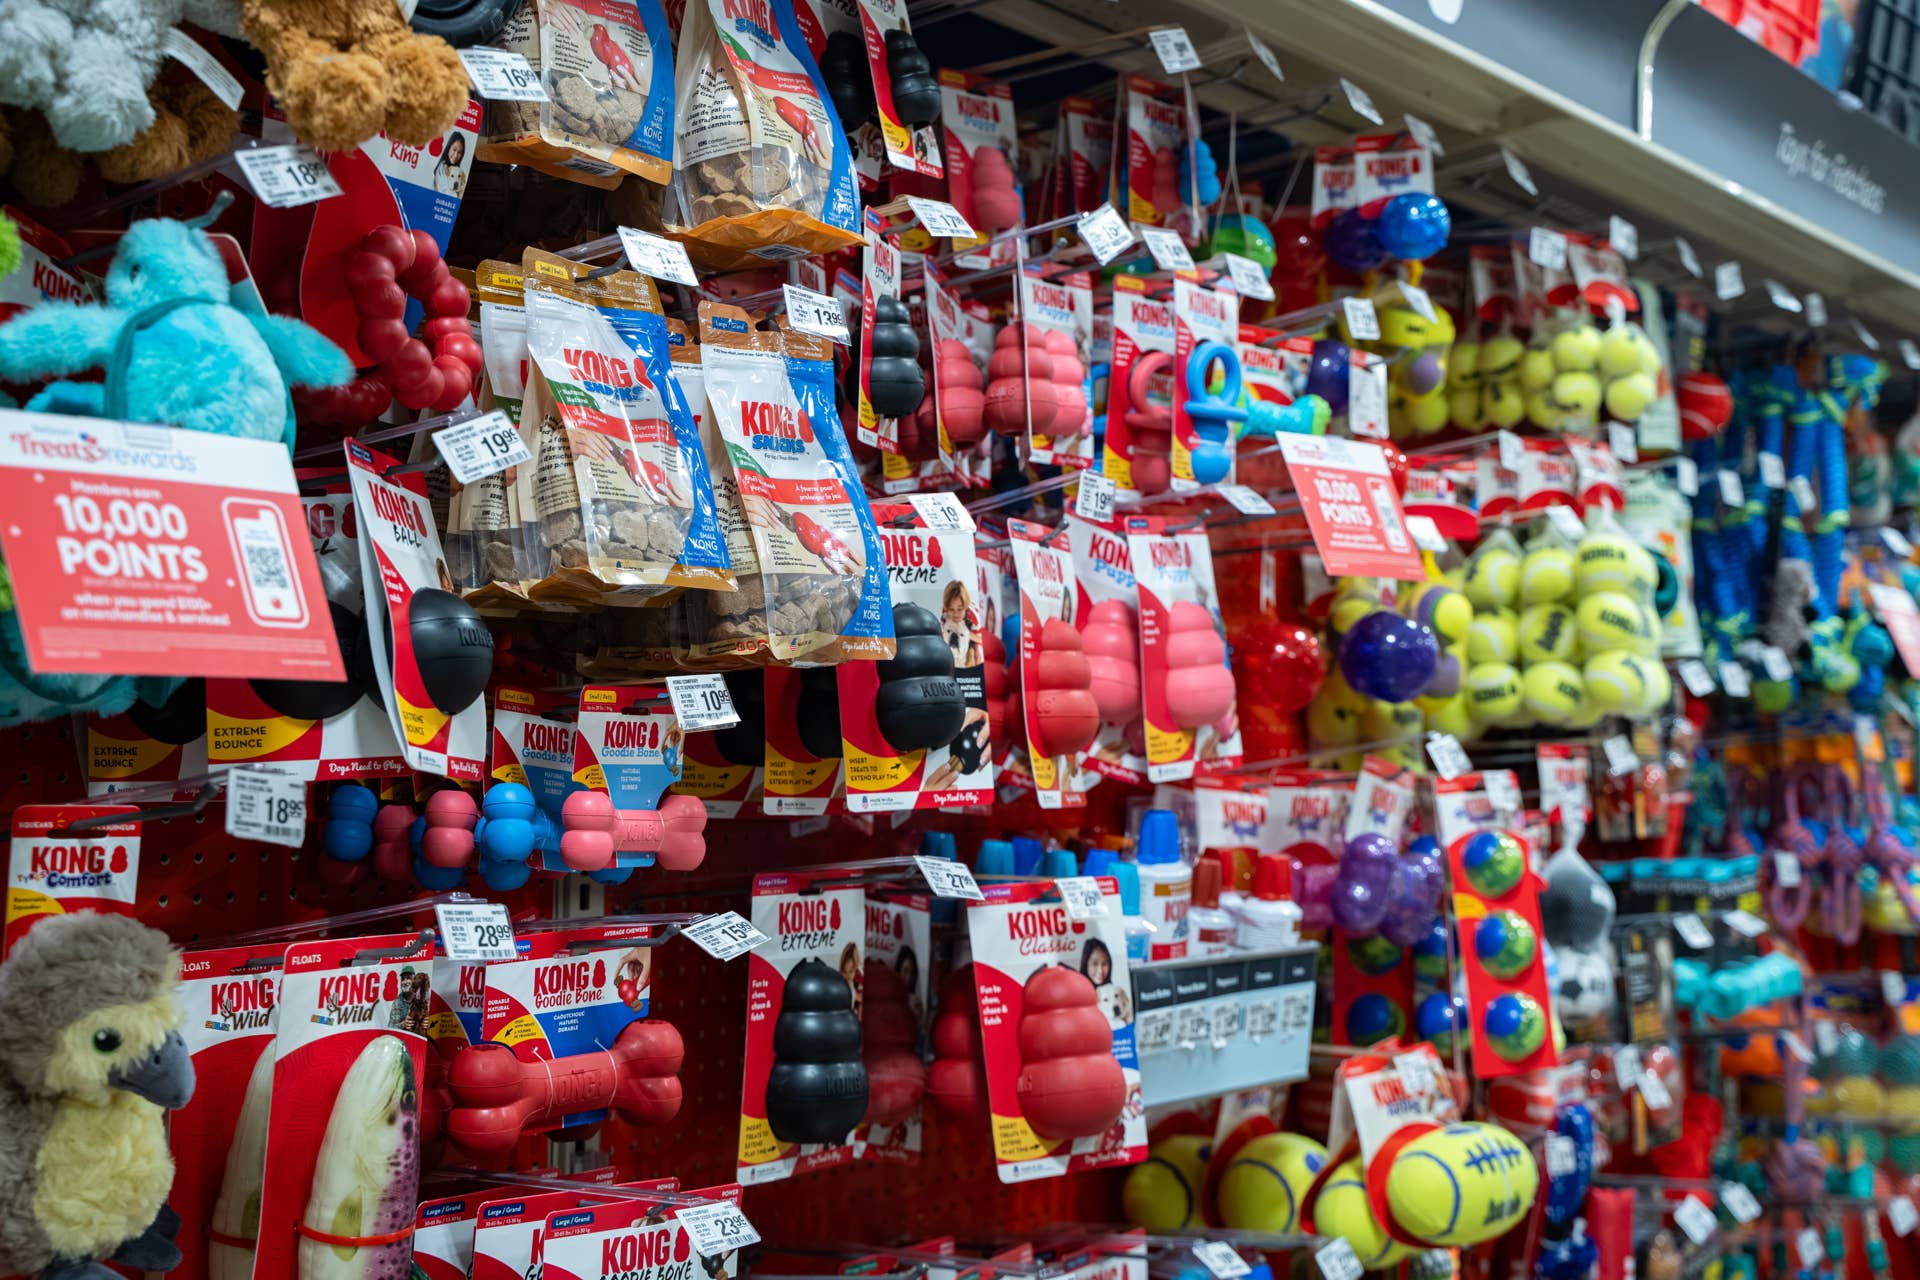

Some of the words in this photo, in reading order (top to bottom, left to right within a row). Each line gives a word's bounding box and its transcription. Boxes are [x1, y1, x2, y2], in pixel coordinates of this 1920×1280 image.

[643, 124, 663, 142] KONG
[390, 139, 419, 169] Ring
[1031, 283, 1066, 308] KONG
[1131, 301, 1168, 327] KONG
[564, 348, 633, 387] KONG
[741, 401, 795, 440] KONG
[752, 434, 805, 454] SNACKS
[102, 448, 198, 473] rewards
[367, 480, 416, 532] KONG
[1318, 500, 1373, 527] POINTS
[55, 494, 189, 542] 10,000
[393, 524, 422, 548] BALL
[691, 537, 718, 551] KONG
[56, 537, 209, 583] POINTS
[883, 535, 923, 567] ONG
[1093, 558, 1137, 587] Pupp
[863, 608, 881, 621] KONG
[457, 627, 495, 648] KONG
[920, 682, 956, 699] KONG
[214, 726, 267, 738] EXTREME
[523, 721, 569, 754] KONG
[604, 720, 648, 749] KONG
[94, 746, 138, 758] EXTREME
[214, 738, 263, 750] BOUNCE
[601, 746, 634, 758] Goodie
[636, 746, 660, 758] Bone
[94, 758, 135, 769] BOUNCE
[521, 747, 557, 763] Goodie
[559, 750, 573, 764] Bo
[329, 761, 351, 776] Dogs
[351, 761, 372, 772] Need
[373, 761, 382, 770] to
[850, 774, 872, 782] EXTEND
[620, 775, 641, 783] TEETHING
[621, 783, 639, 791] RUBBER
[31, 845, 106, 875] KONG
[47, 871, 113, 888] Comfort
[778, 898, 828, 936] KONG
[1008, 908, 1067, 940] KONG
[604, 929, 625, 937] AVERAGE
[625, 926, 649, 935] CHEWERS
[781, 930, 837, 952] EXTREME
[1019, 935, 1077, 957] Classic
[179, 961, 211, 973] FLOATS
[291, 953, 322, 966] FLOATS
[534, 961, 590, 997] KONG
[211, 977, 275, 1016] KONG
[318, 971, 381, 1009] KONG
[535, 990, 572, 1009] Goodie
[575, 986, 603, 1004] Bone
[487, 997, 510, 1006] DURABLE
[487, 1005, 510, 1013] NATURAL
[231, 1003, 275, 1031] Wild
[337, 999, 380, 1025] Wild
[487, 1012, 507, 1020] RUBBER
[553, 1011, 585, 1020] CAOUTCHOUC
[557, 1025, 579, 1033] DURABLE
[558, 1019, 579, 1027] NATUREL
[656, 1183, 676, 1191] POWER
[426, 1206, 441, 1217] Large
[445, 1203, 462, 1213] Grand
[487, 1208, 502, 1218] Large
[505, 1204, 522, 1213] Grand
[555, 1218, 570, 1228] Large
[574, 1215, 591, 1225] Grand
[601, 1228, 671, 1276] KONG
[656, 1259, 694, 1280] BONE
